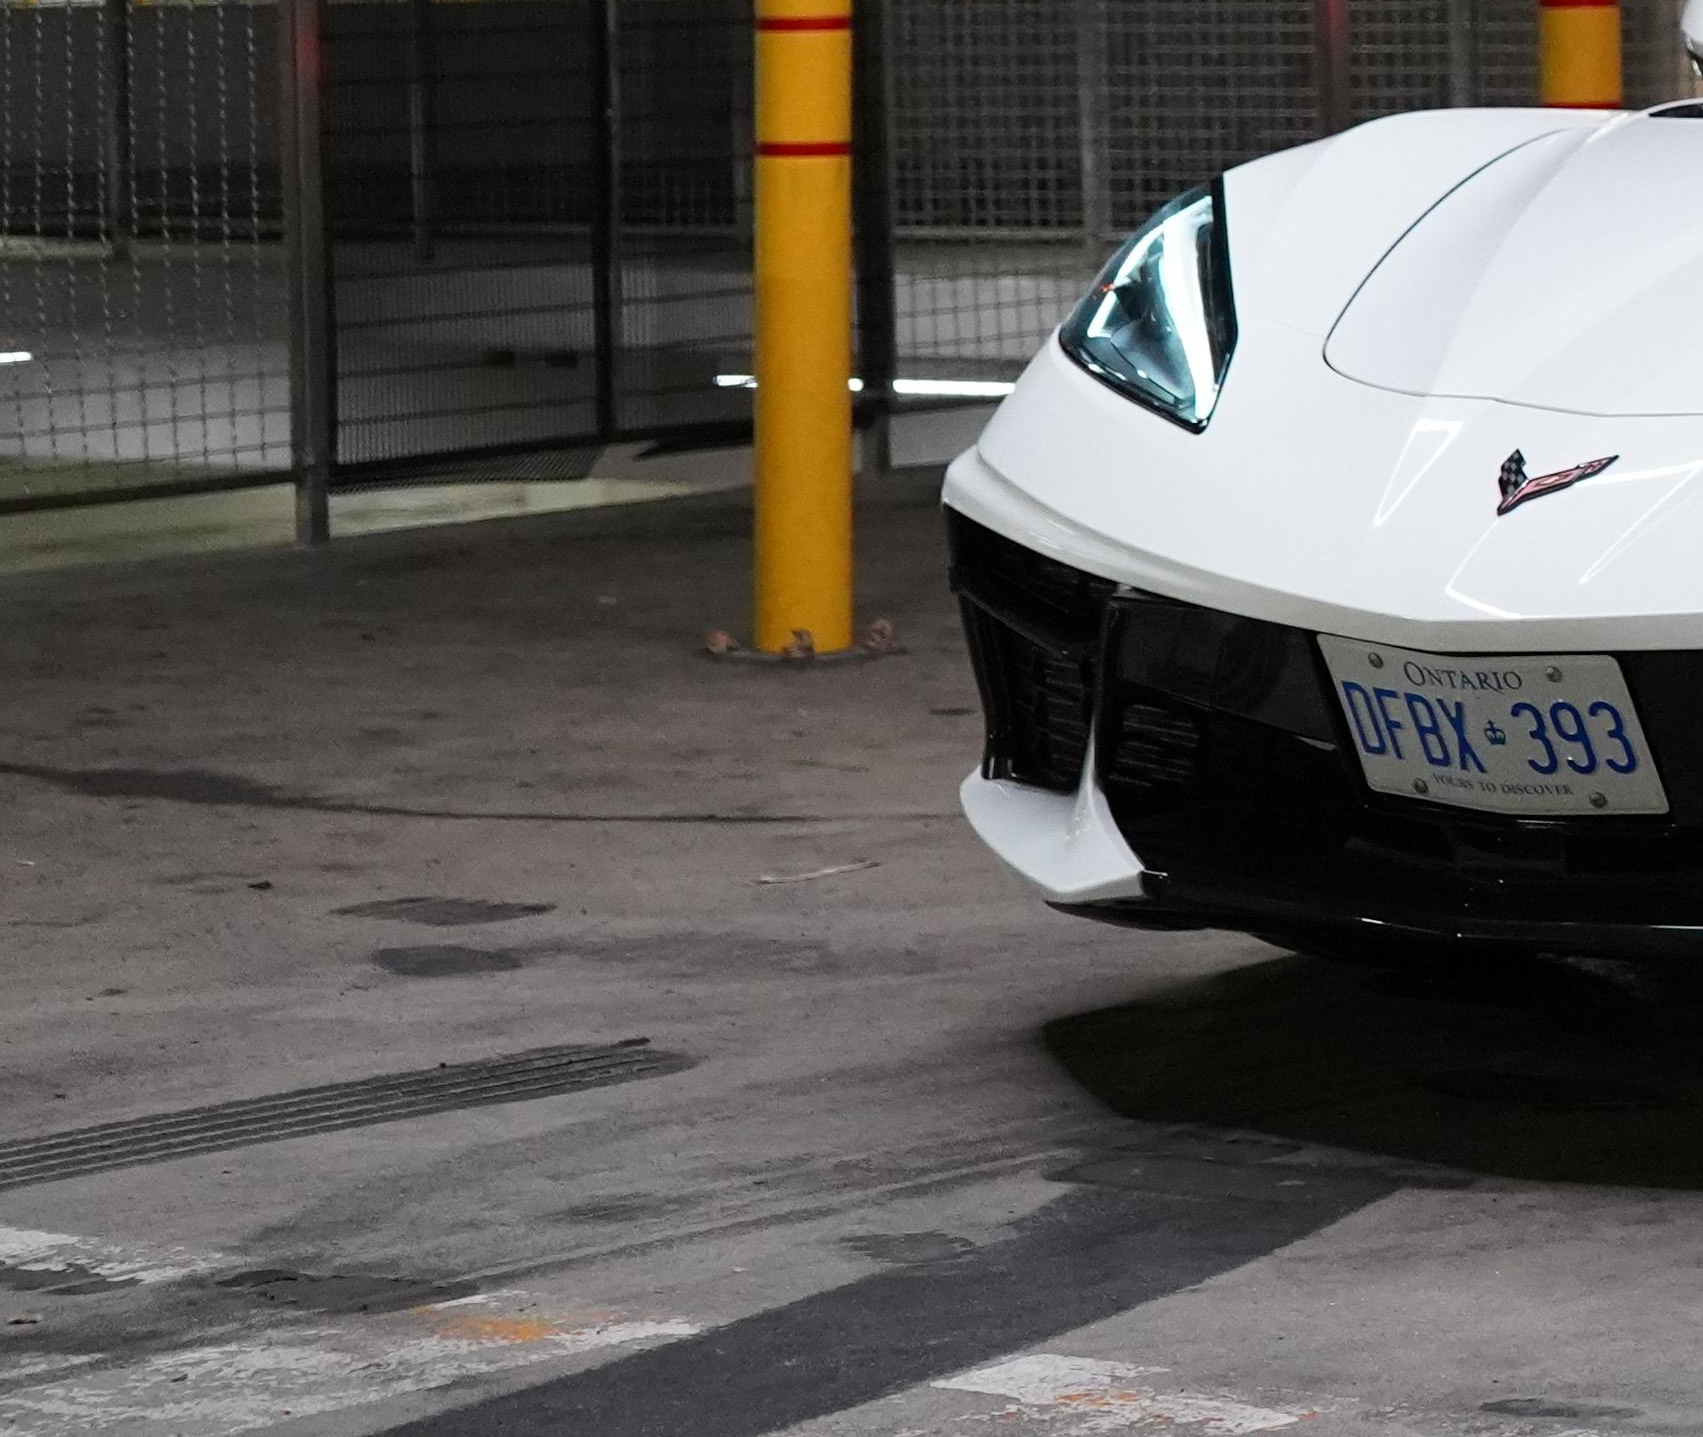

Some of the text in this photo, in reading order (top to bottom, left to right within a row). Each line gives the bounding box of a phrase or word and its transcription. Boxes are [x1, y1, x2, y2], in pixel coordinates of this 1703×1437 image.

[1403, 661, 1522, 693] ONTARIO
[1341, 681, 1637, 775] DFBX 393
[1433, 772, 1574, 796] YOURS TO DISCOVER
